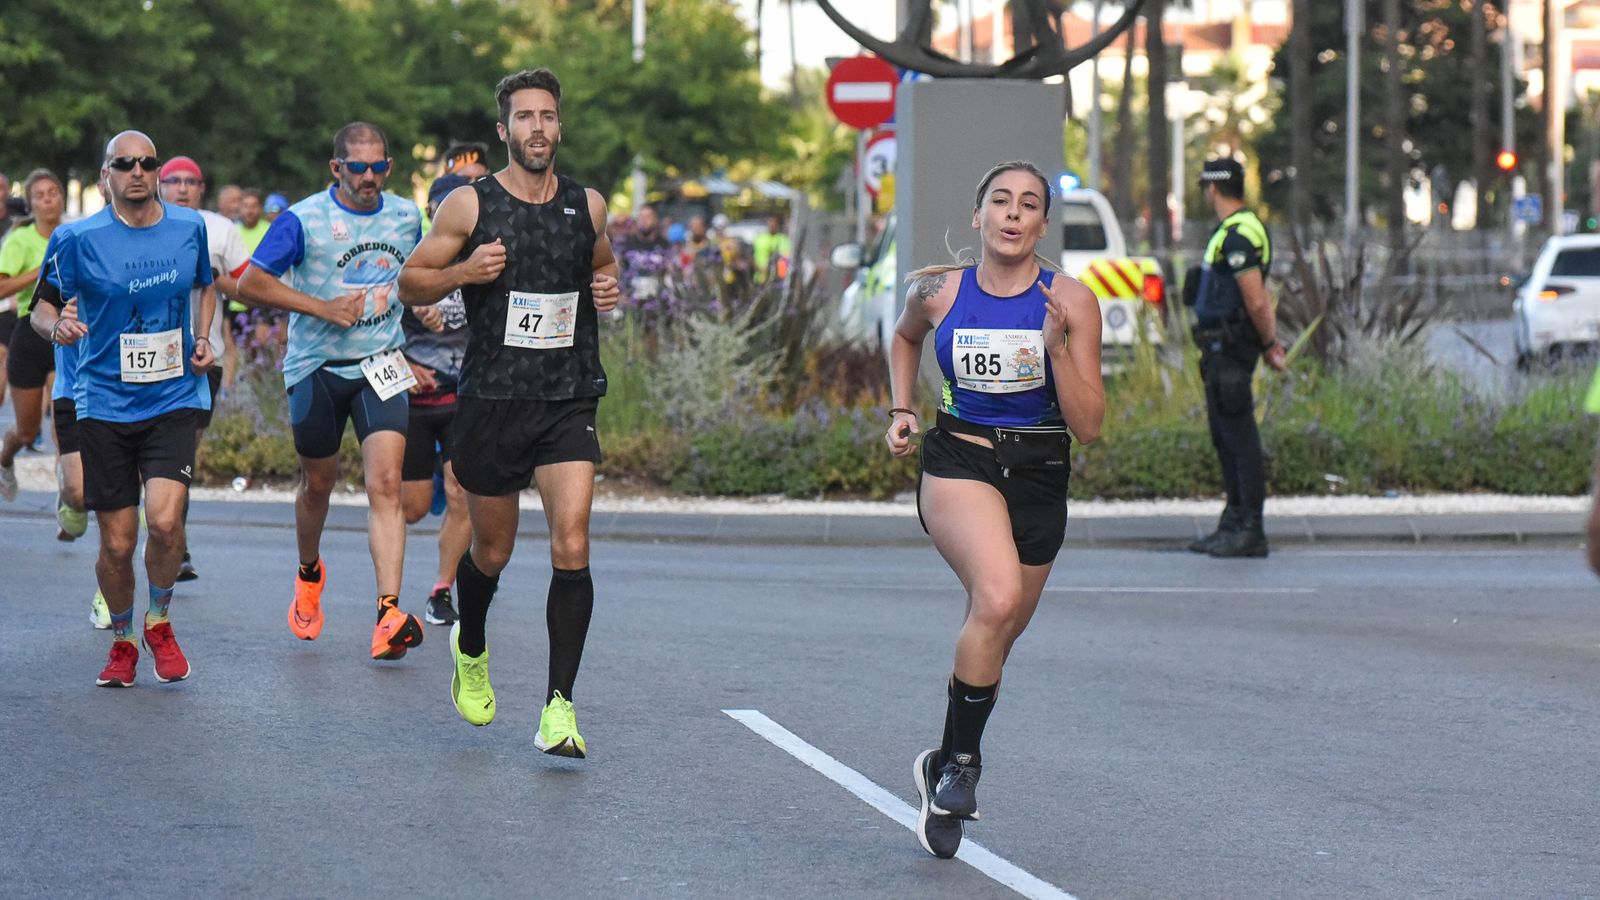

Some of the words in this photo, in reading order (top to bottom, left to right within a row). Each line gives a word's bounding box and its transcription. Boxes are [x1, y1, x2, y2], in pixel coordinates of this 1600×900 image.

[125, 258, 177, 270] BAJADILLA
[337, 242, 406, 268] CORREDORES
[129, 269, 179, 294] Running
[513, 297, 526, 306] XXI
[518, 313, 543, 333] 47
[957, 335, 973, 345] XXI
[126, 351, 157, 369] 157
[961, 352, 1002, 377] 185
[374, 364, 398, 386] 146
